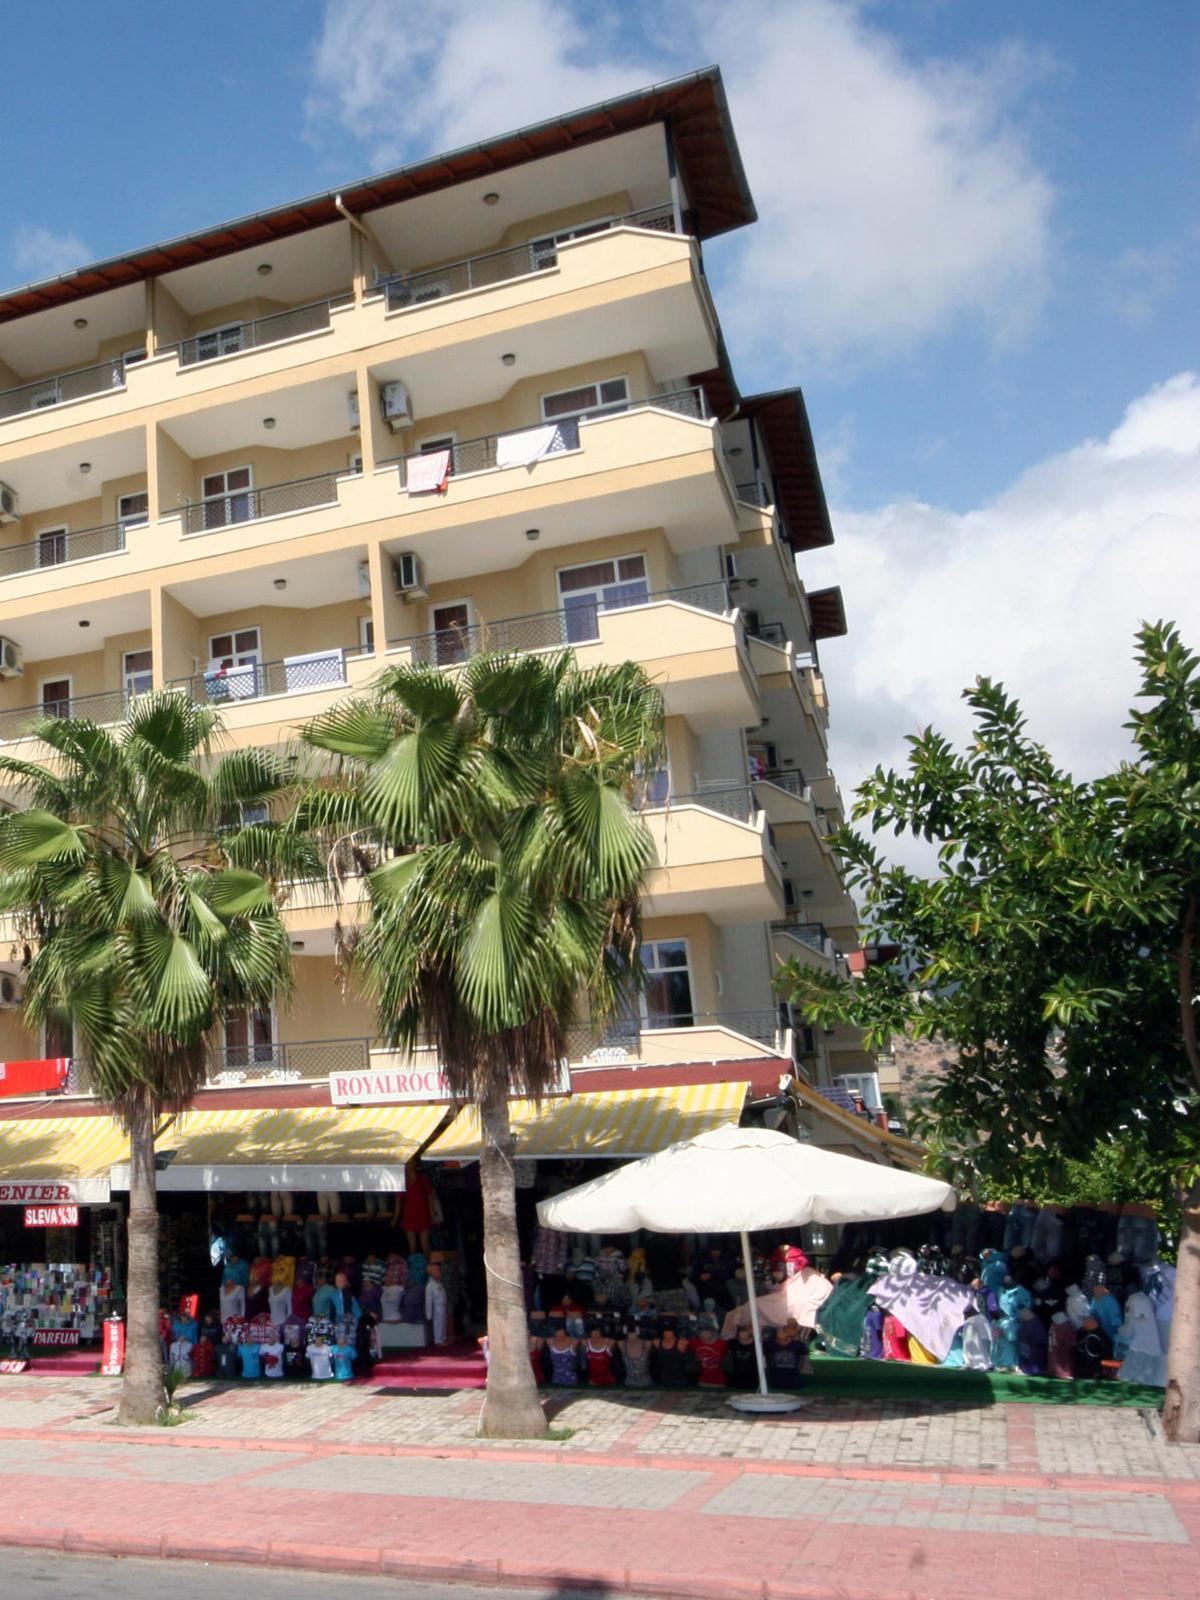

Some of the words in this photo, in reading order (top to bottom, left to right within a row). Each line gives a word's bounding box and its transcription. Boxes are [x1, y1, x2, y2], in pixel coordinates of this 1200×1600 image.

[25, 1208, 57, 1225] SLEVA
[57, 1206, 79, 1225] %30
[33, 1331, 80, 1345] PARFUM
